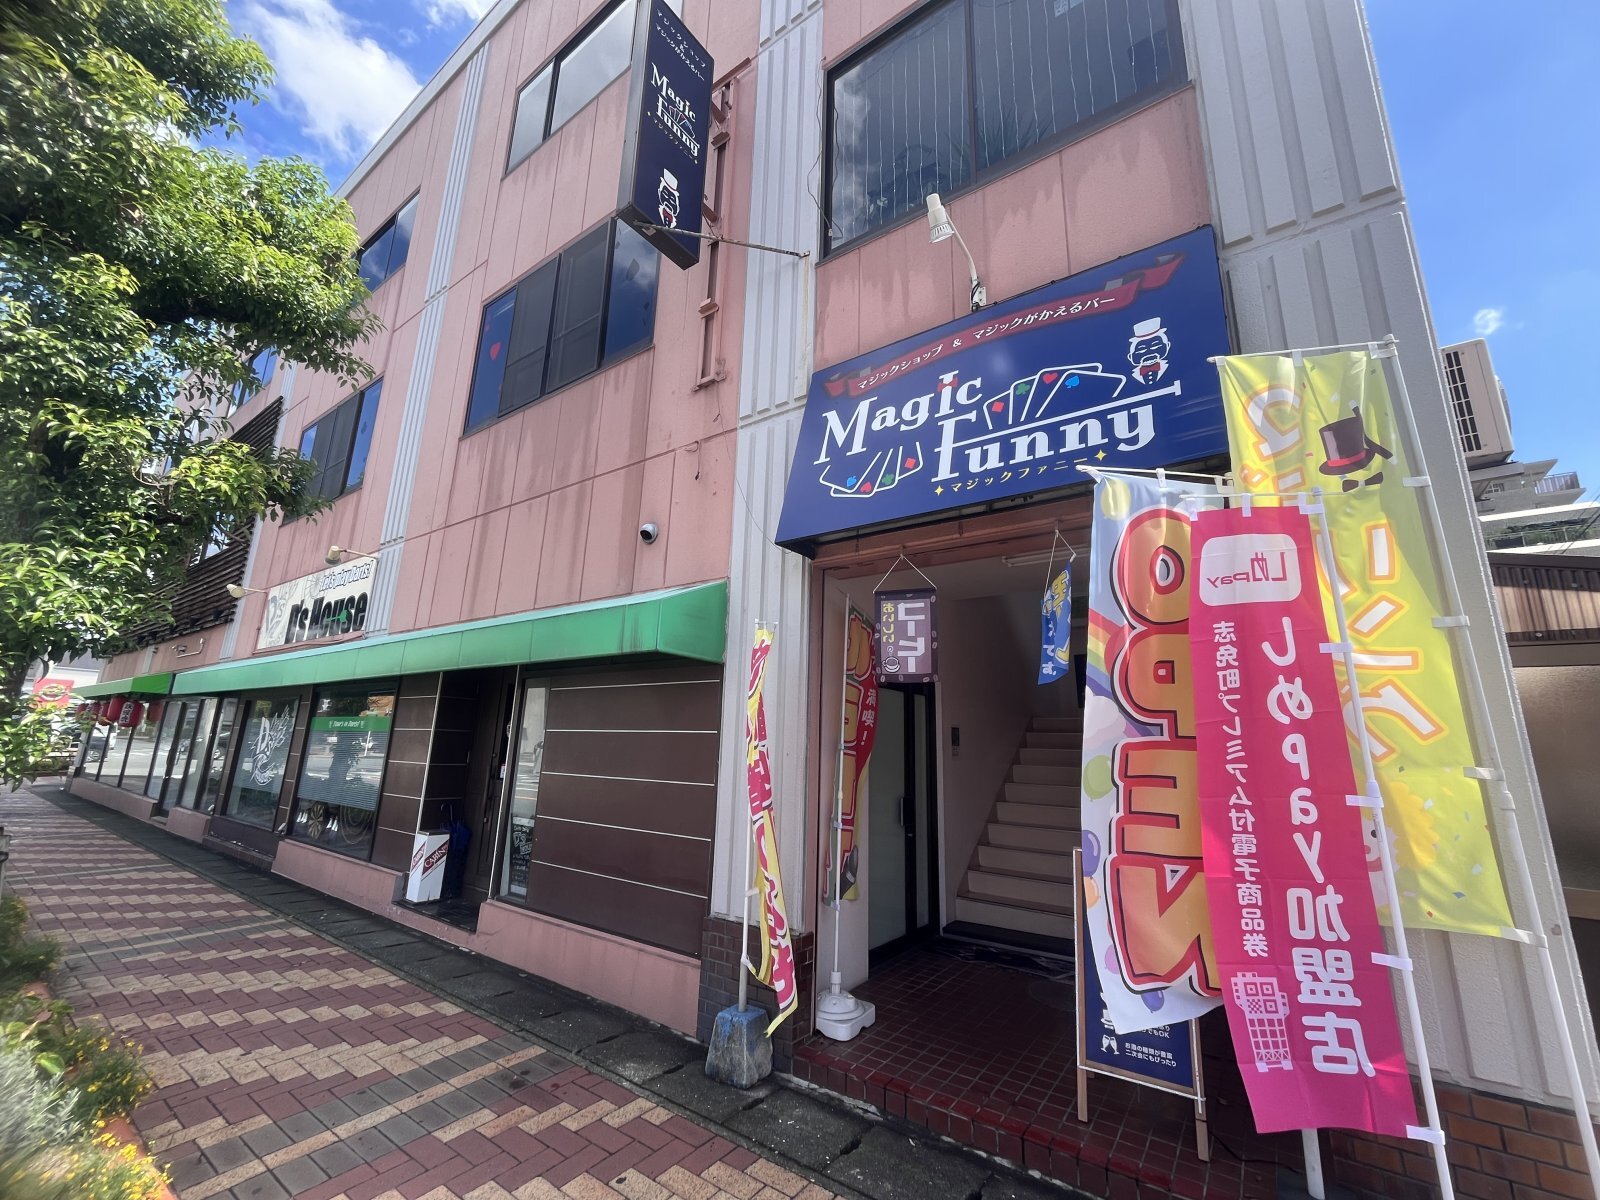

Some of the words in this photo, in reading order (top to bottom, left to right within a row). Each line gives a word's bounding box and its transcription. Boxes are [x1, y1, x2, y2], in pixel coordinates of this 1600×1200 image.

[657, 9, 706, 67] マジックショップ
[651, 62, 696, 122] Magic
[656, 94, 700, 157] Funny
[857, 344, 944, 390] マジックショップ
[952, 338, 963, 349] &
[973, 297, 1116, 340] マジックがかえるバー
[813, 370, 983, 466] Magic
[931, 390, 1175, 483] Funny
[950, 457, 1090, 492] マジックファニー
[284, 599, 310, 644] D's
[307, 591, 369, 641] House
[424, 847, 446, 868] CABIN
